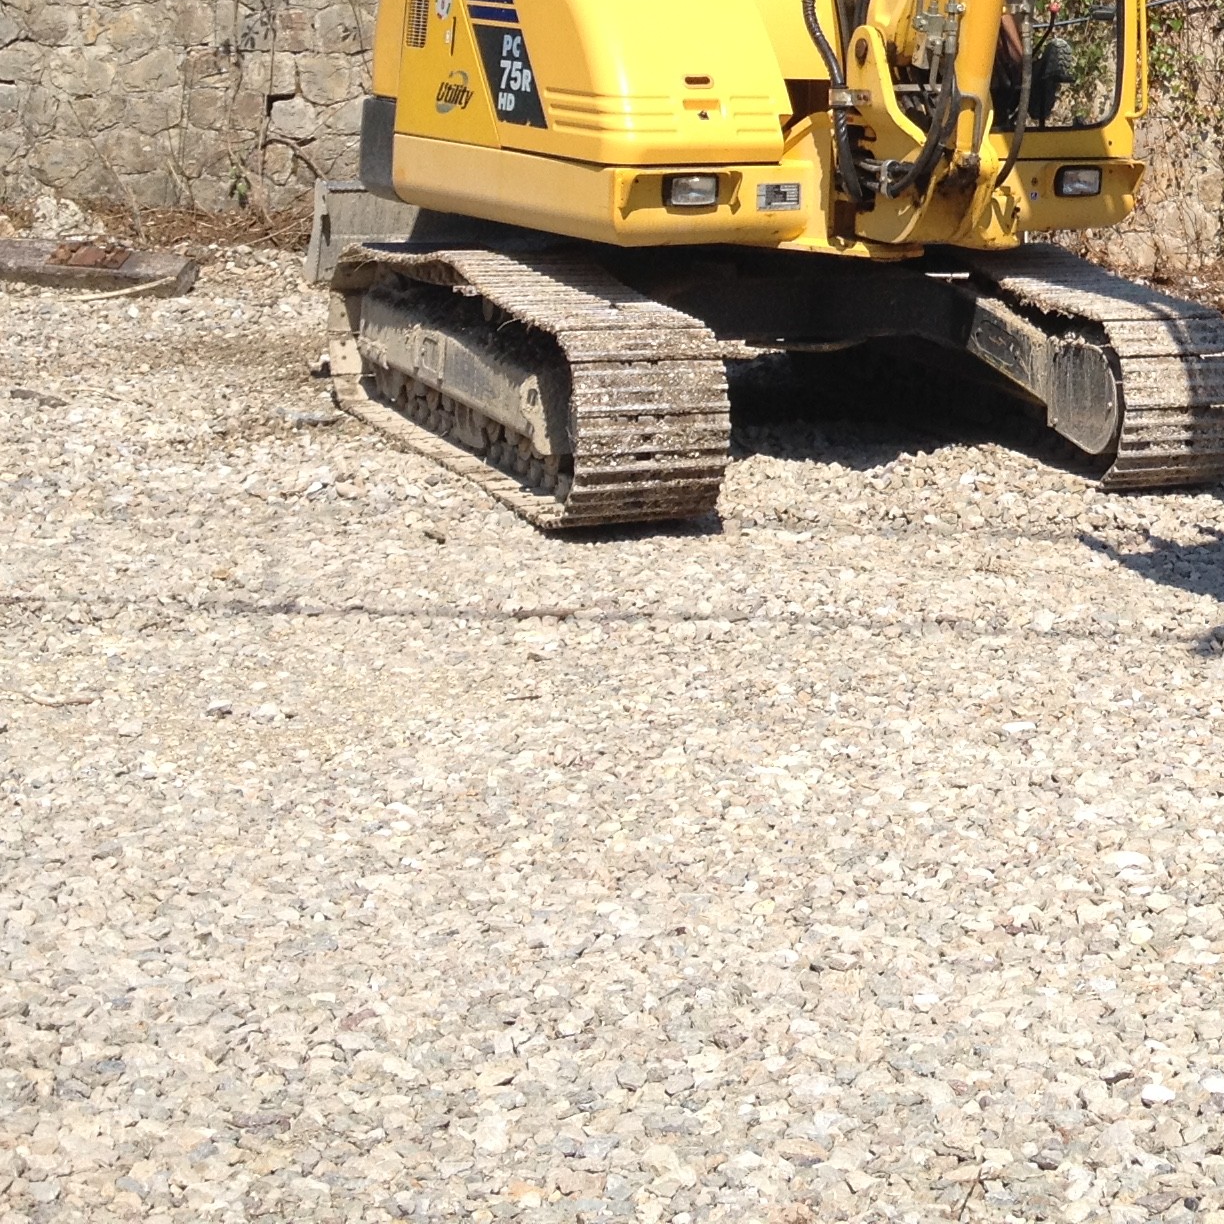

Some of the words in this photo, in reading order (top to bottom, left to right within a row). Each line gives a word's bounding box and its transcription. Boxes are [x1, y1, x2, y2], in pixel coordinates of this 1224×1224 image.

[502, 34, 522, 58] PC
[500, 60, 531, 92] 75R
[436, 81, 474, 110] Utility
[498, 92, 516, 112] HD
